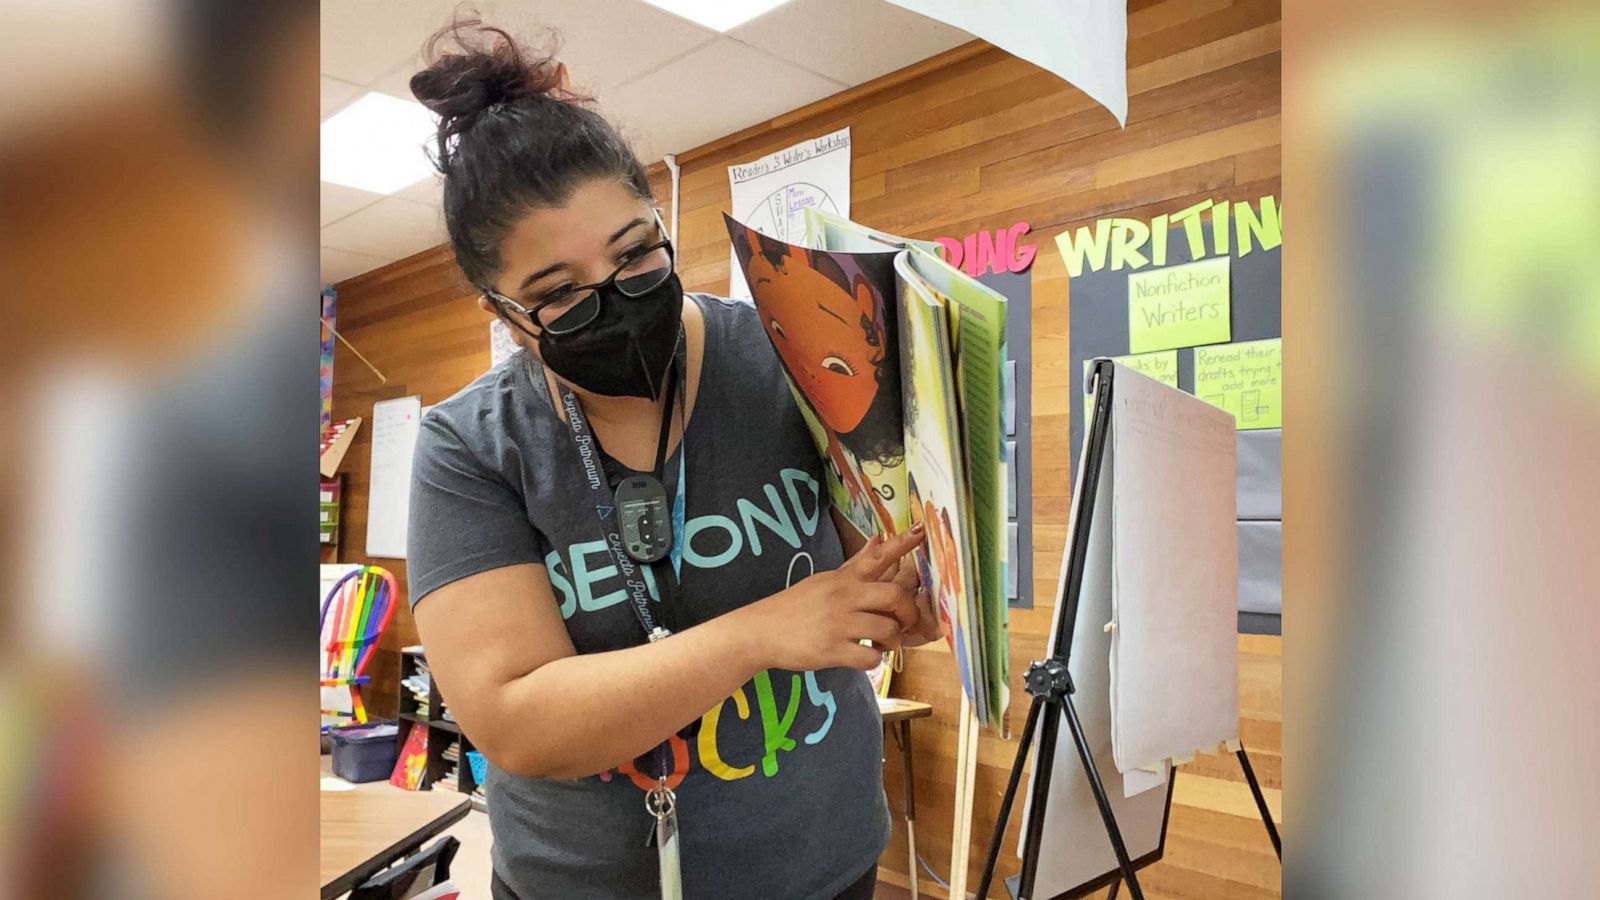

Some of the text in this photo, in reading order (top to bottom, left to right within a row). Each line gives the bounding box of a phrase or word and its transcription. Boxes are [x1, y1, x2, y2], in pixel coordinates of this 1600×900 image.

[814, 133, 849, 154] Workshop
[934, 222, 1037, 277] DING
[1054, 195, 1282, 278] WRITIN
[1135, 271, 1221, 298] Nonfiction
[1141, 300, 1220, 328] Writers
[1198, 346, 1276, 366] Reread their
[1198, 366, 1235, 382] drafts
[1222, 380, 1244, 391] add
[575, 434, 601, 490] Patronum
[545, 468, 819, 620] SEOND
[599, 669, 837, 793] OCKS
